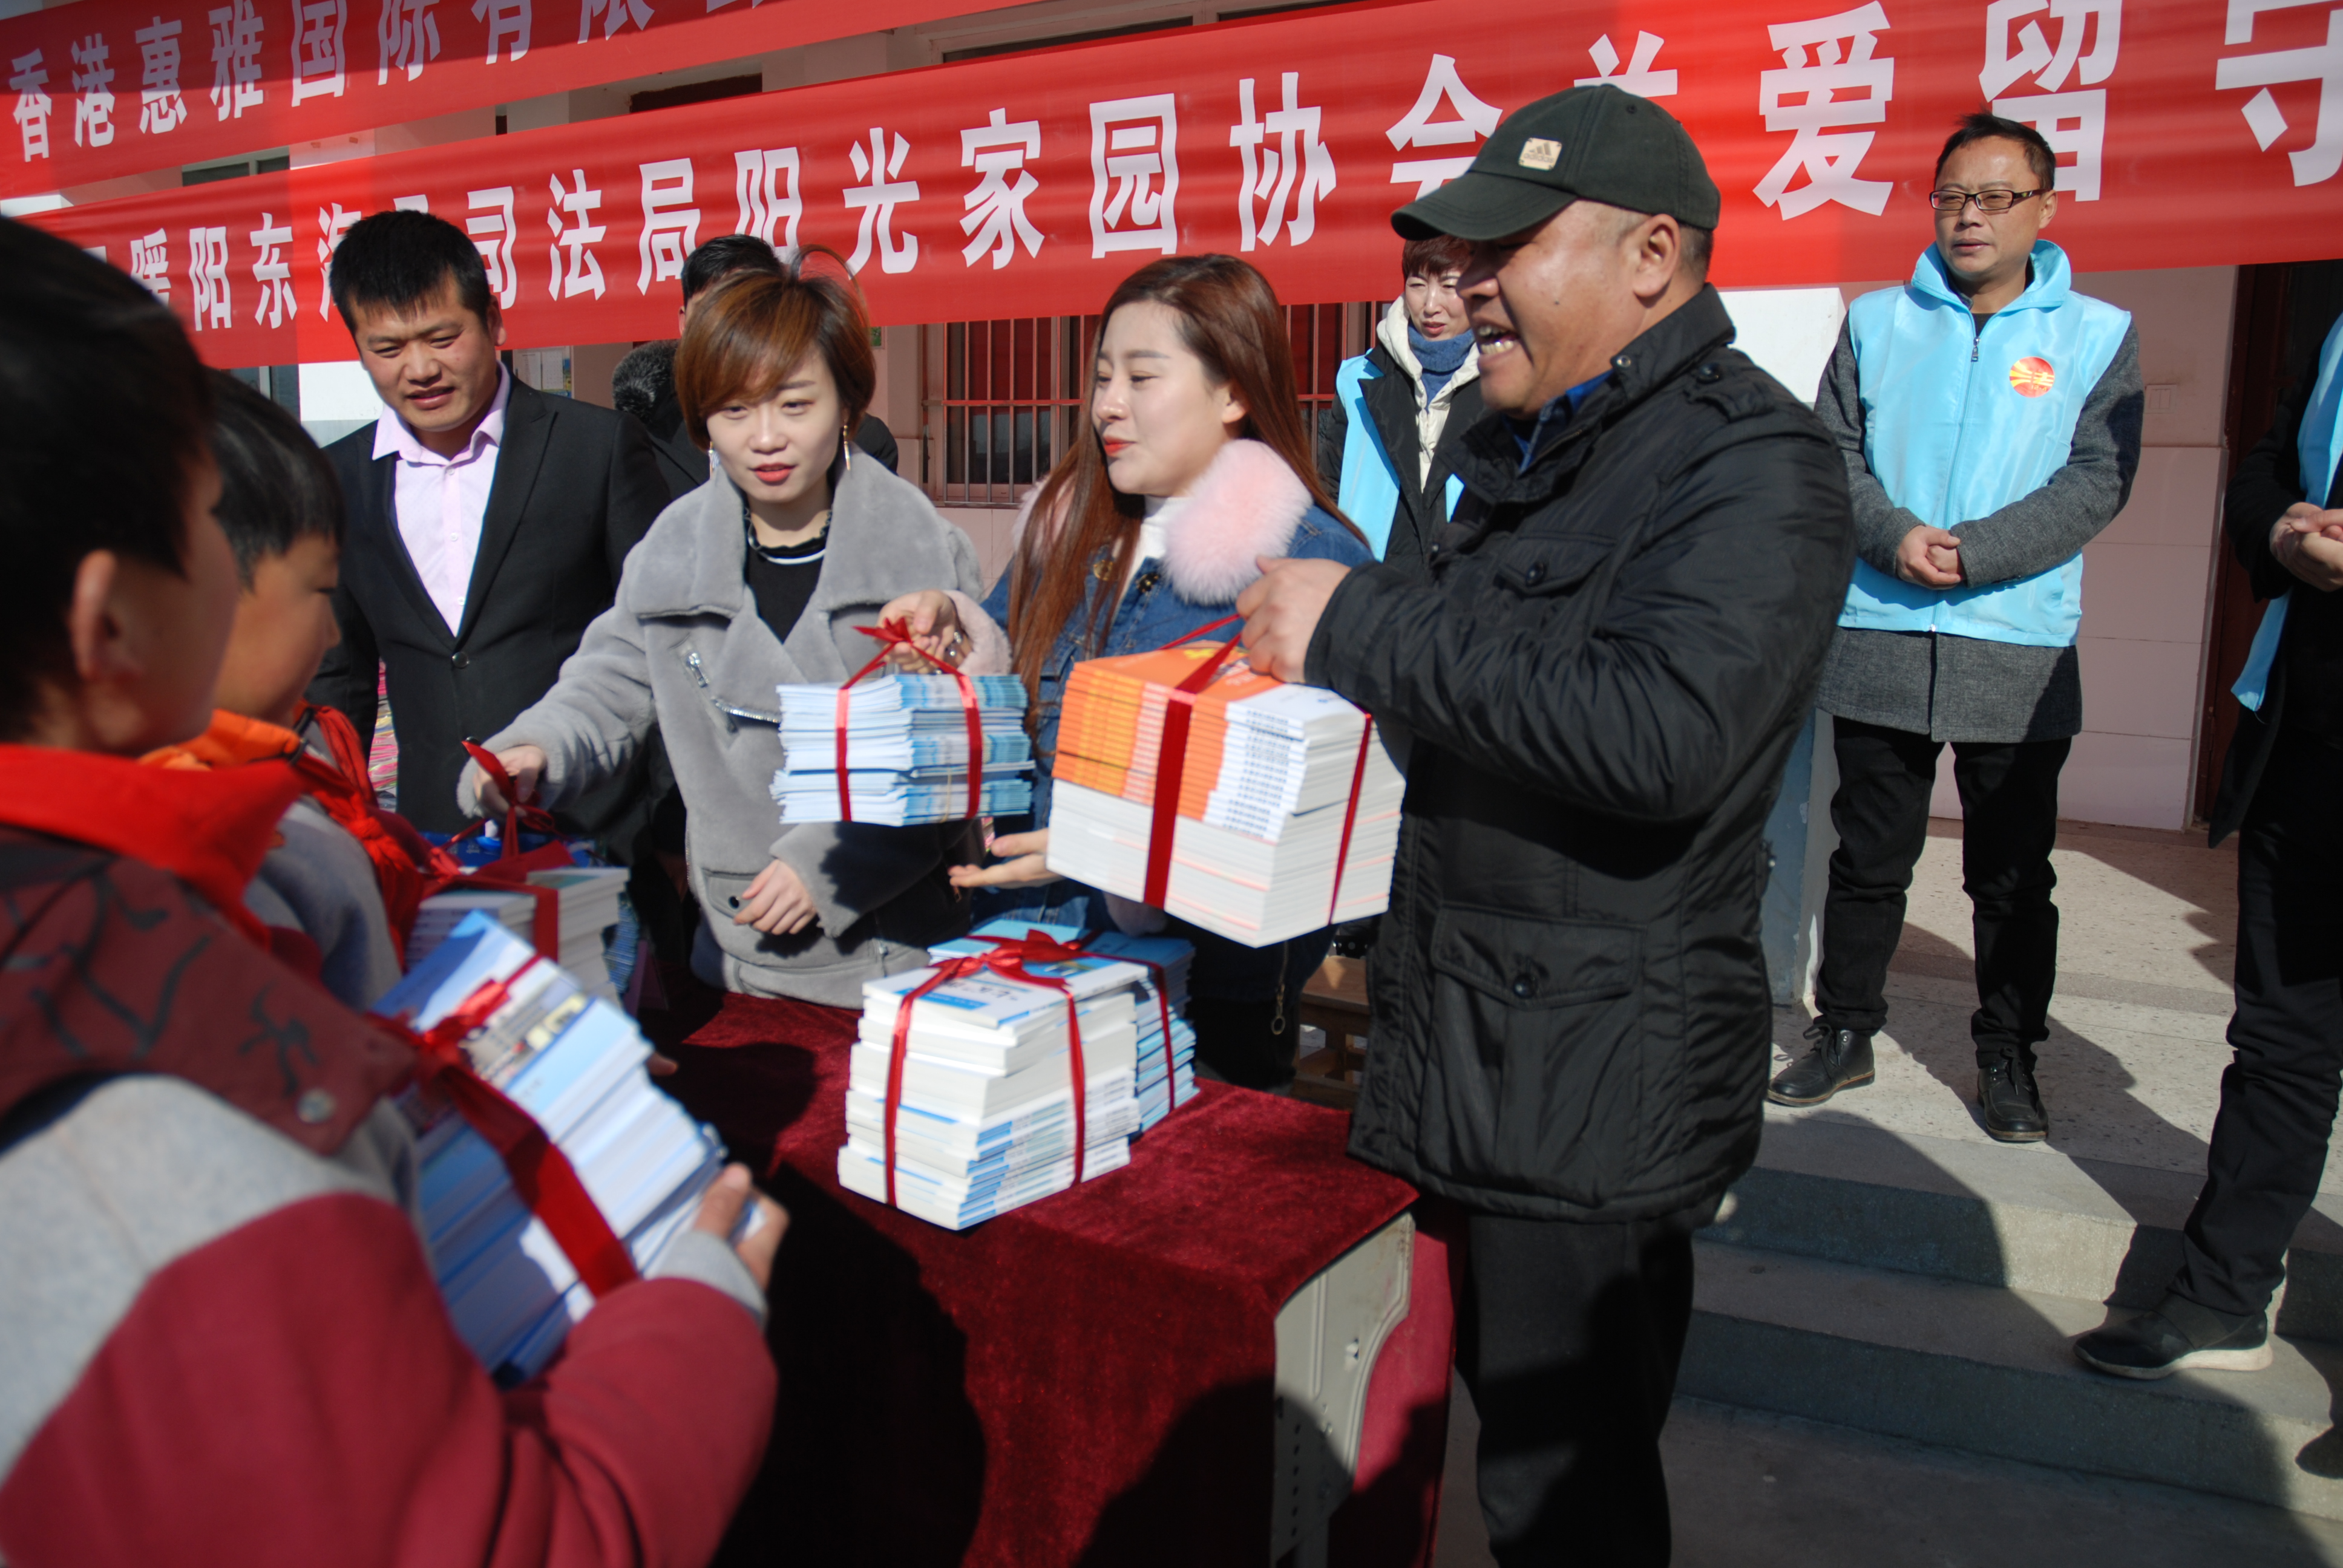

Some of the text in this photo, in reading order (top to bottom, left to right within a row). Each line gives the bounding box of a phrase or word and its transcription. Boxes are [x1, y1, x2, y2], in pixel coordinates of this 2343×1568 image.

[9, 0, 765, 162] 香港惠雅国际有
